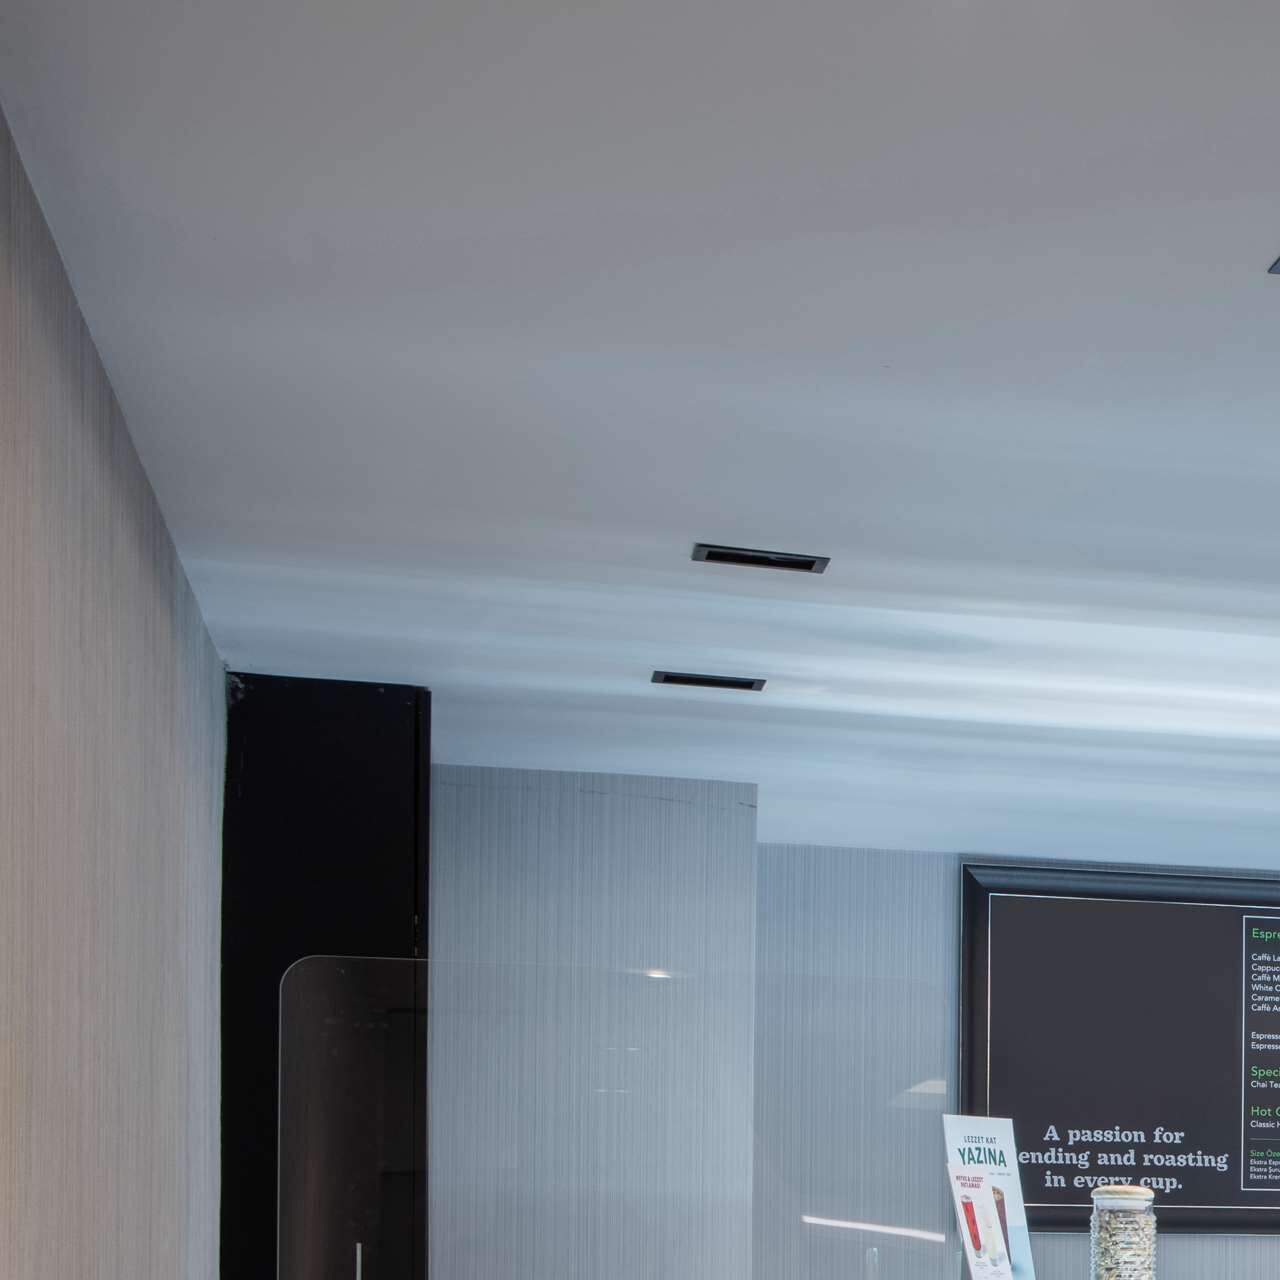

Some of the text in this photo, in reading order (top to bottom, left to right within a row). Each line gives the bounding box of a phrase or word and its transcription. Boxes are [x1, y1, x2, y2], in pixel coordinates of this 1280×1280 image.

[1252, 954, 1271, 962] Caffè
[1252, 974, 1271, 982] Caffè
[1251, 984, 1273, 992] White
[1251, 1004, 1271, 1012] Caffè
[1251, 1107, 1271, 1117] Hot
[1043, 1125, 1185, 1145] A passion for
[958, 1147, 1007, 1167] YAZINA
[1019, 1150, 1228, 1171] ending and roasting
[1045, 1171, 1066, 1187] in
[1139, 1175, 1183, 1193] cup.
